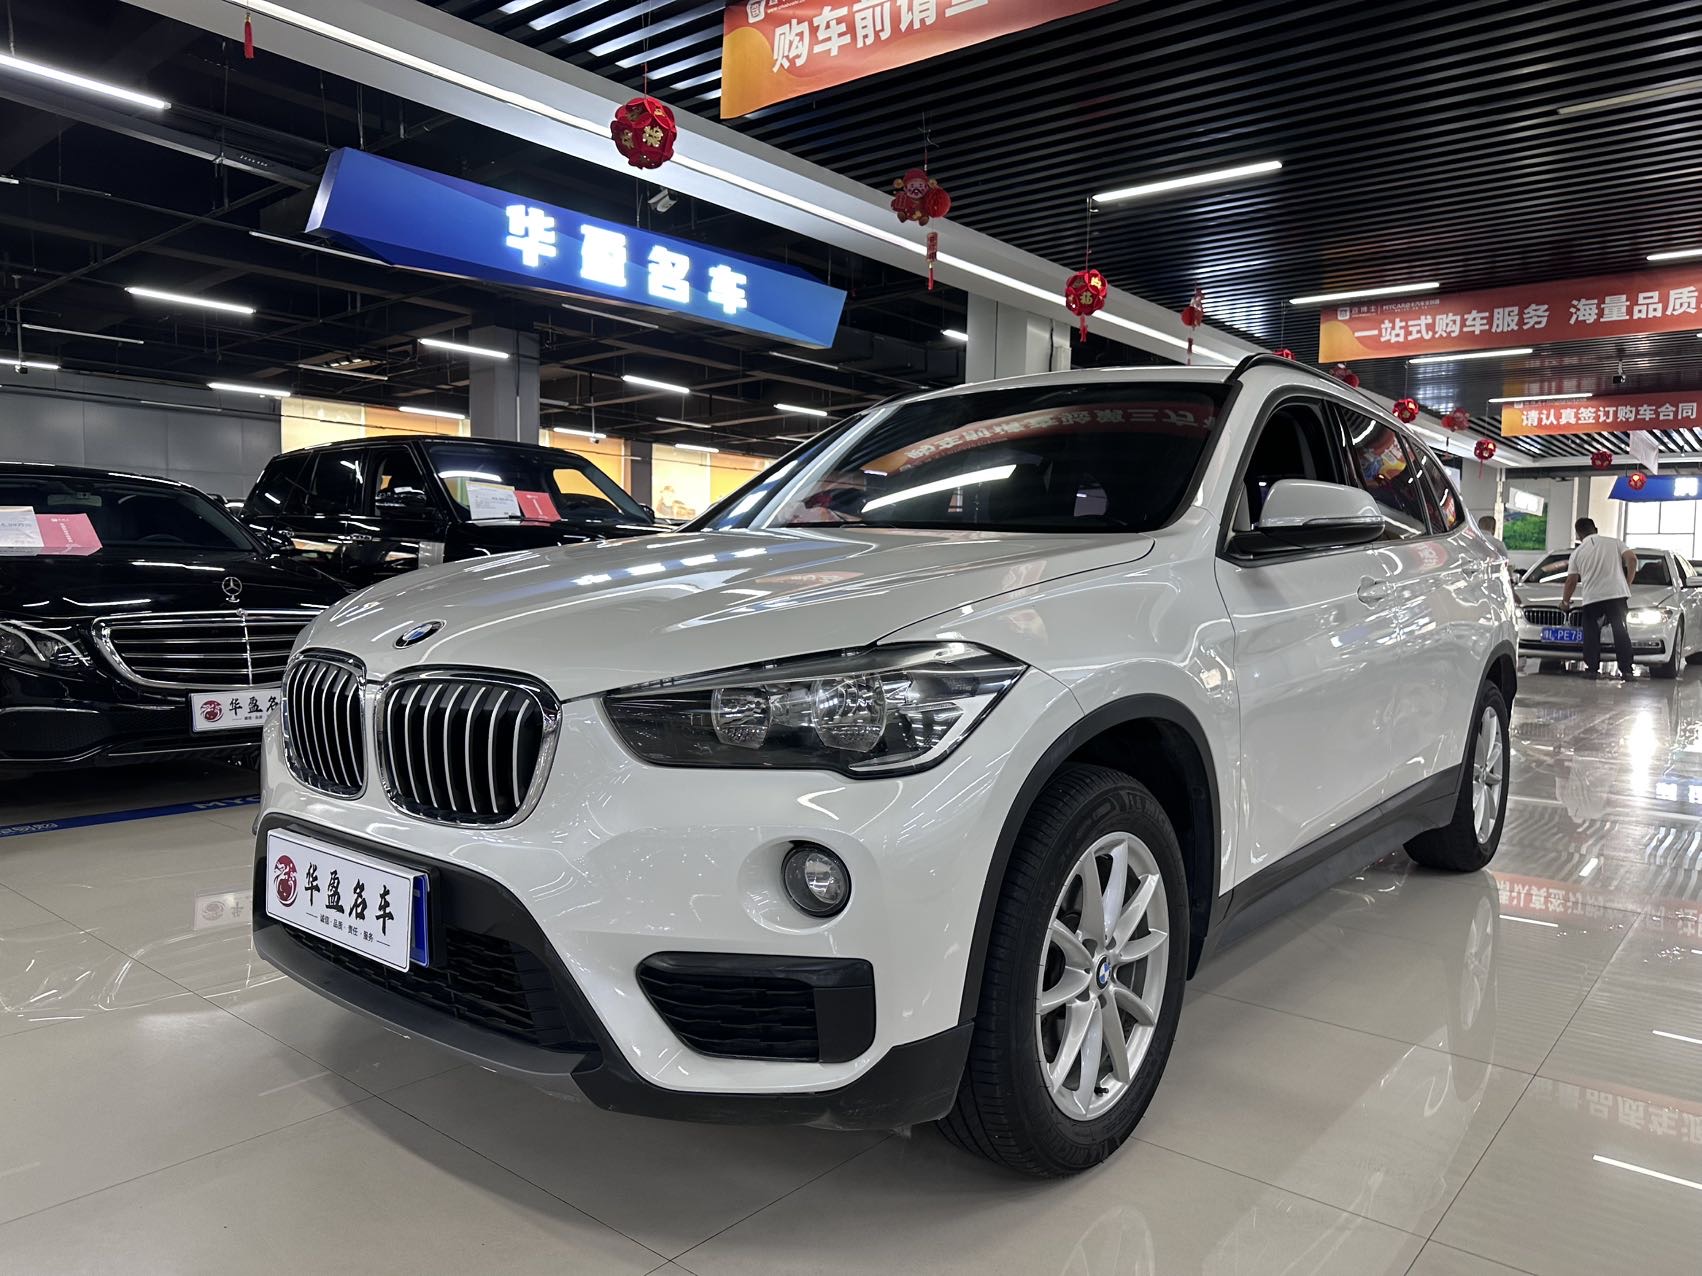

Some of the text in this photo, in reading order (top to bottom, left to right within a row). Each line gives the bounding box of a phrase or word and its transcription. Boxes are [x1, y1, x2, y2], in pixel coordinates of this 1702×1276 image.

[1354, 304, 1550, 344] 一站式购车服务
[1568, 286, 1702, 325] 海量品质
[1521, 402, 1697, 427] 请认真签订购车合同
[304, 862, 395, 936] 华盈名车
